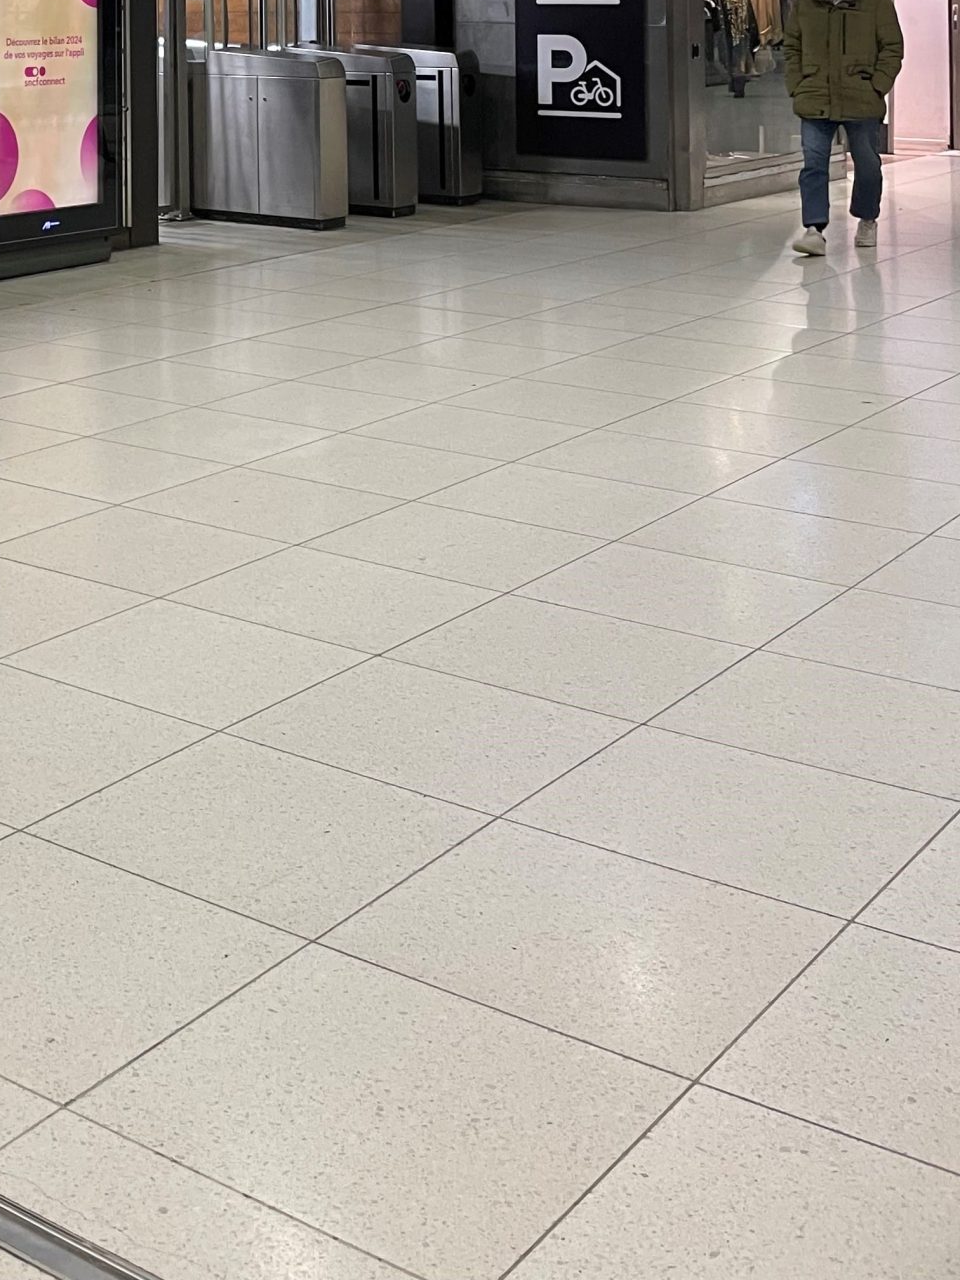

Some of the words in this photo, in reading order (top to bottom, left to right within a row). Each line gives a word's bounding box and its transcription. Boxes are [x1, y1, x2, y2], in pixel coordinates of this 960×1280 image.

[5, 37, 41, 47] Découvrez
[41, 36, 48, 45] le
[49, 36, 65, 45] bilan
[66, 35, 83, 44] 2024
[4, 50, 13, 59] de
[14, 51, 26, 59] vos
[27, 50, 54, 60] voyages
